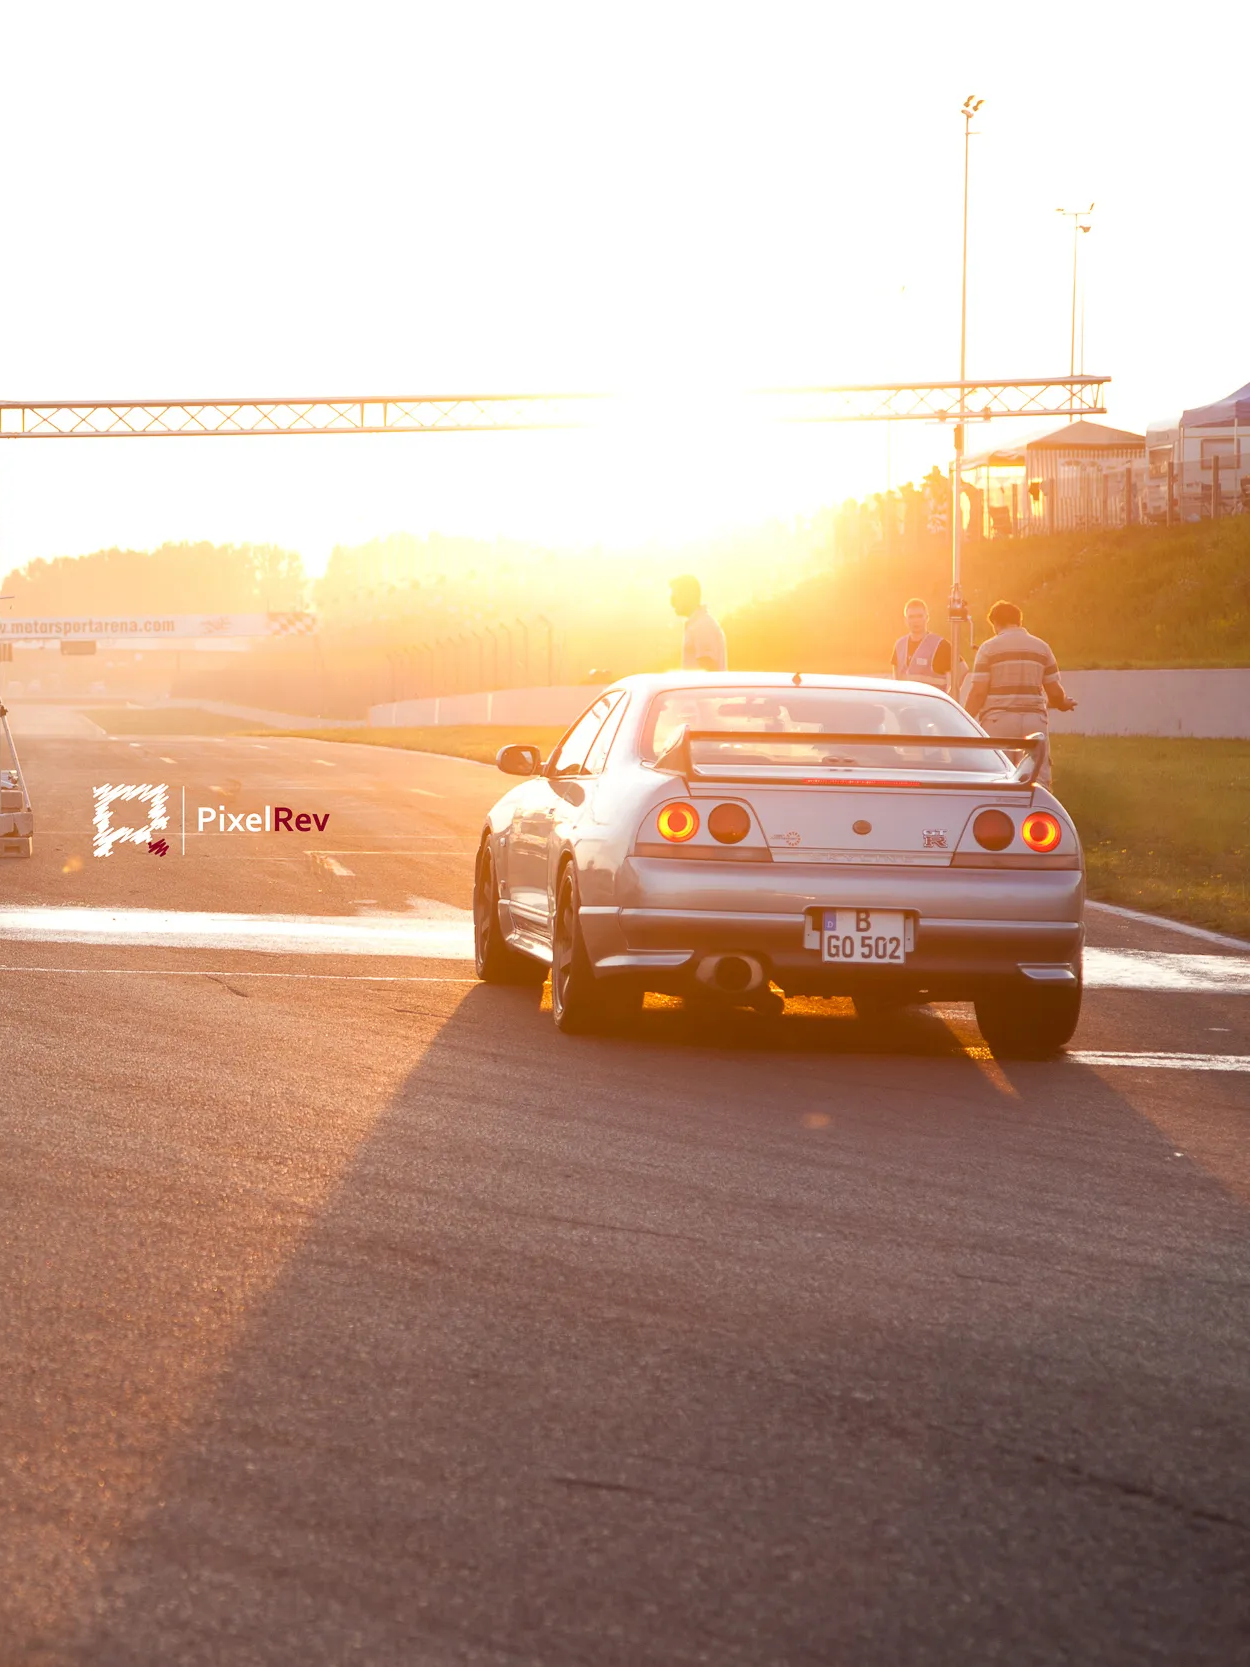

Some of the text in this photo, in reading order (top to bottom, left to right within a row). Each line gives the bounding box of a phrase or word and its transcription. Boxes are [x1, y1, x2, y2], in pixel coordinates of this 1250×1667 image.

[810, 852, 914, 863] SKYLINE
[856, 909, 871, 932] B
[827, 935, 901, 960] GO 502
